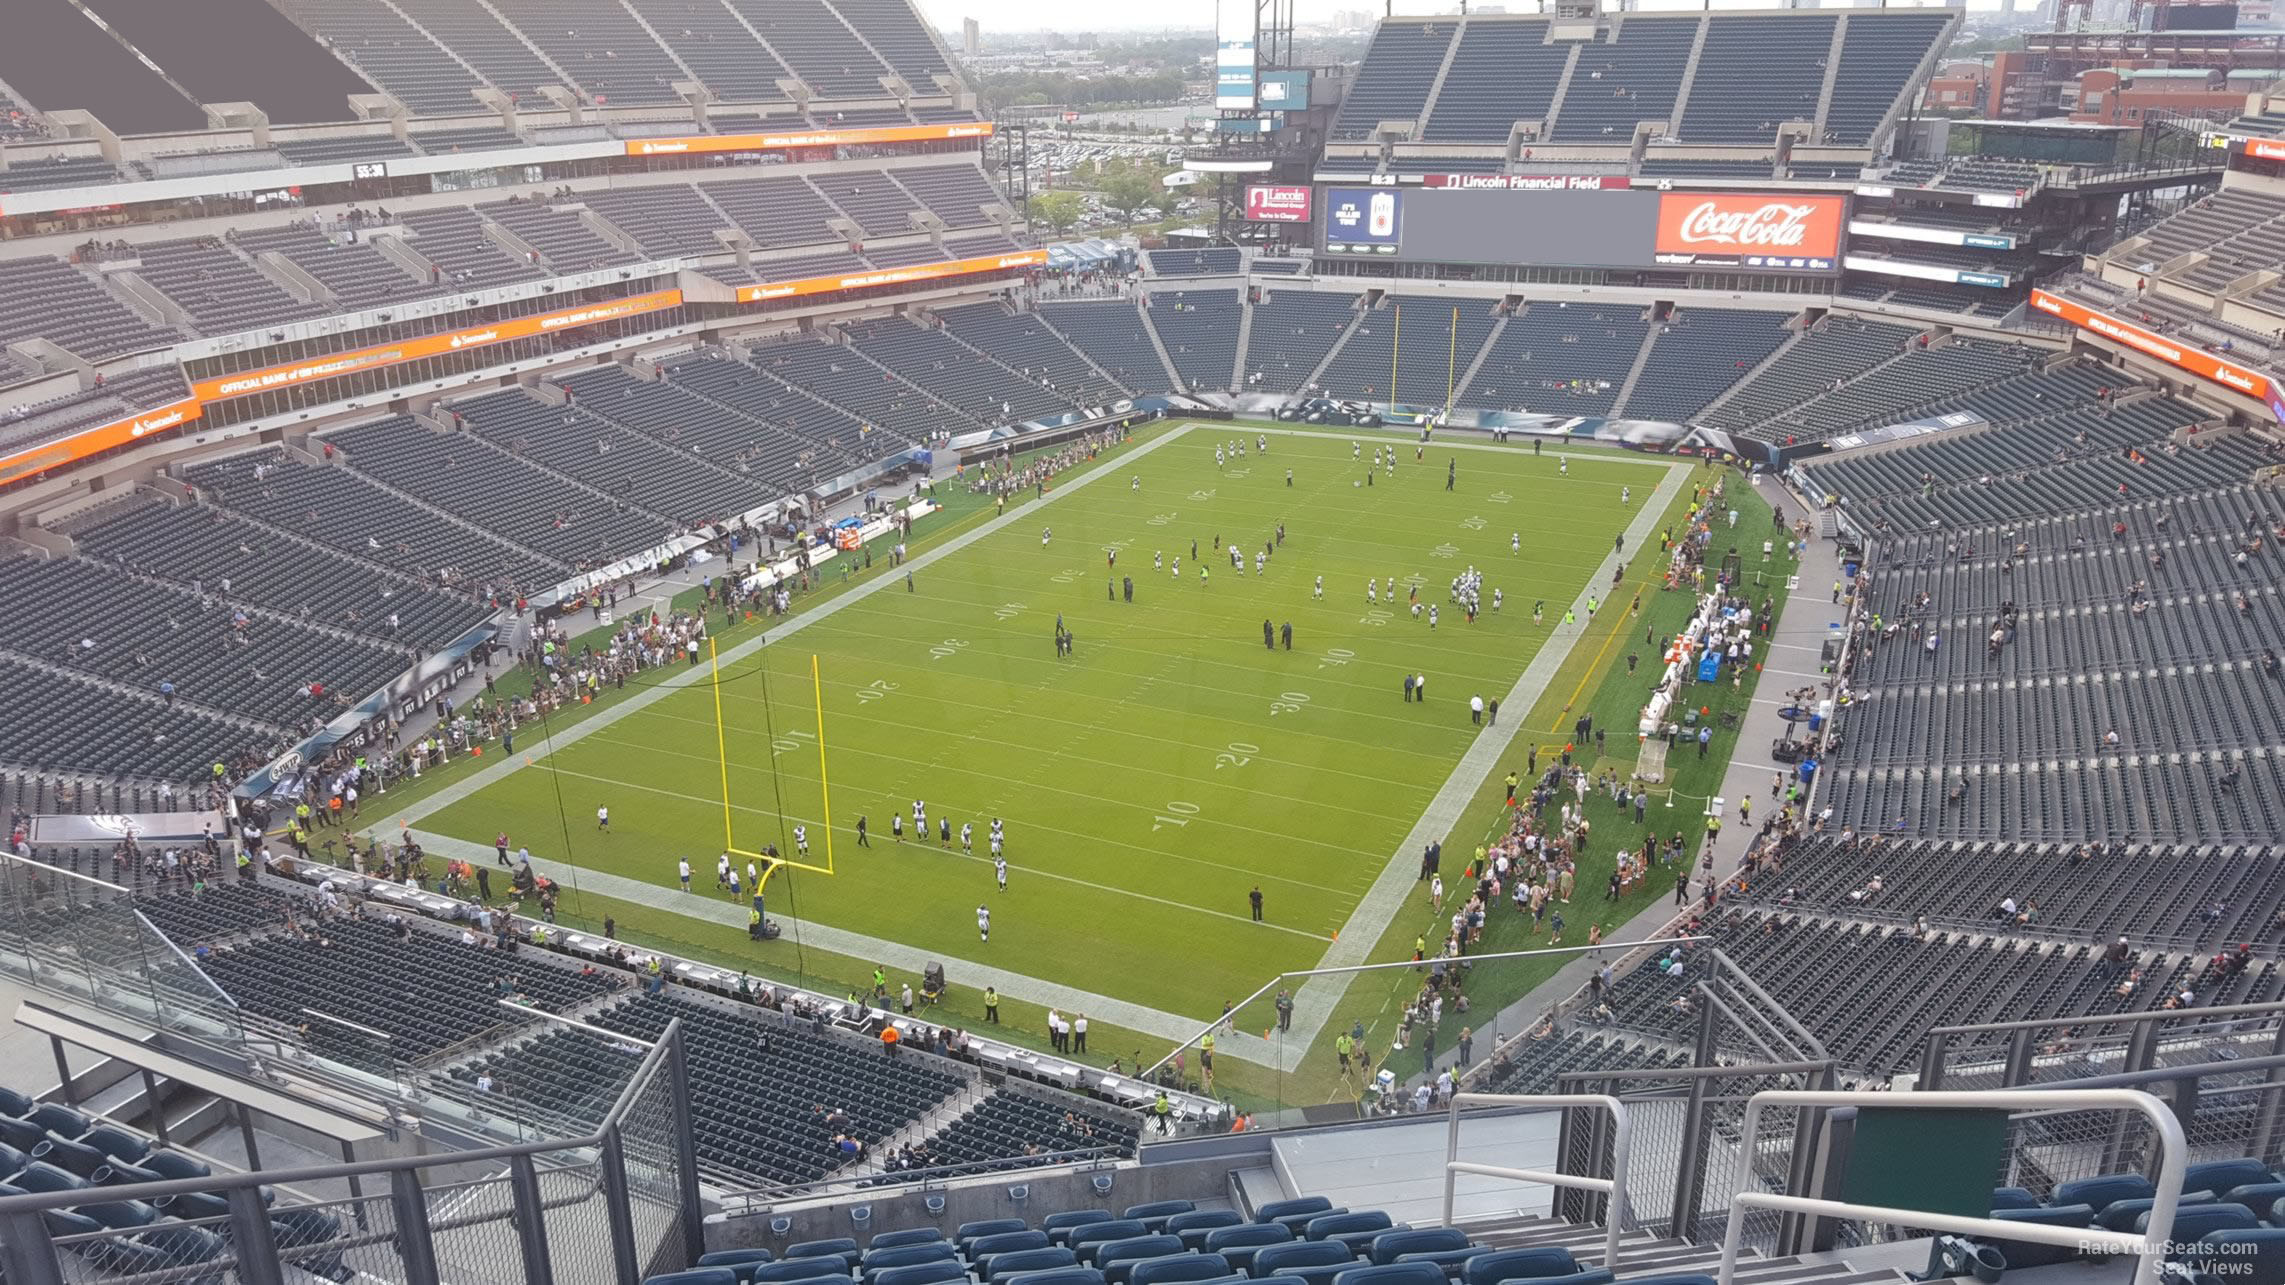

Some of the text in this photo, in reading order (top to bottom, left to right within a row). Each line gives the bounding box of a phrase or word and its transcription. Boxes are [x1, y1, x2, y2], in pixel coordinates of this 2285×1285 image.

[1464, 176, 1601, 190] Lincoln Financial Field
[1269, 188, 1304, 200] Lincoln
[1680, 201, 1816, 245] Coca-Cola
[541, 316, 570, 328] OFFICIAL
[220, 376, 262, 394] OFFICIAL
[262, 372, 288, 387] BANK
[288, 370, 299, 380] of
[2224, 370, 2254, 390] Santander
[143, 412, 183, 432] Santander
[994, 600, 1028, 618] 40
[930, 638, 969, 657] 30
[1320, 648, 1355, 666] 40
[856, 679, 900, 700] 20
[405, 701, 415, 714] FLY
[1271, 692, 1311, 713] 30
[772, 729, 816, 751] 10
[1216, 742, 1260, 767] 20
[1155, 801, 1200, 827] 10
